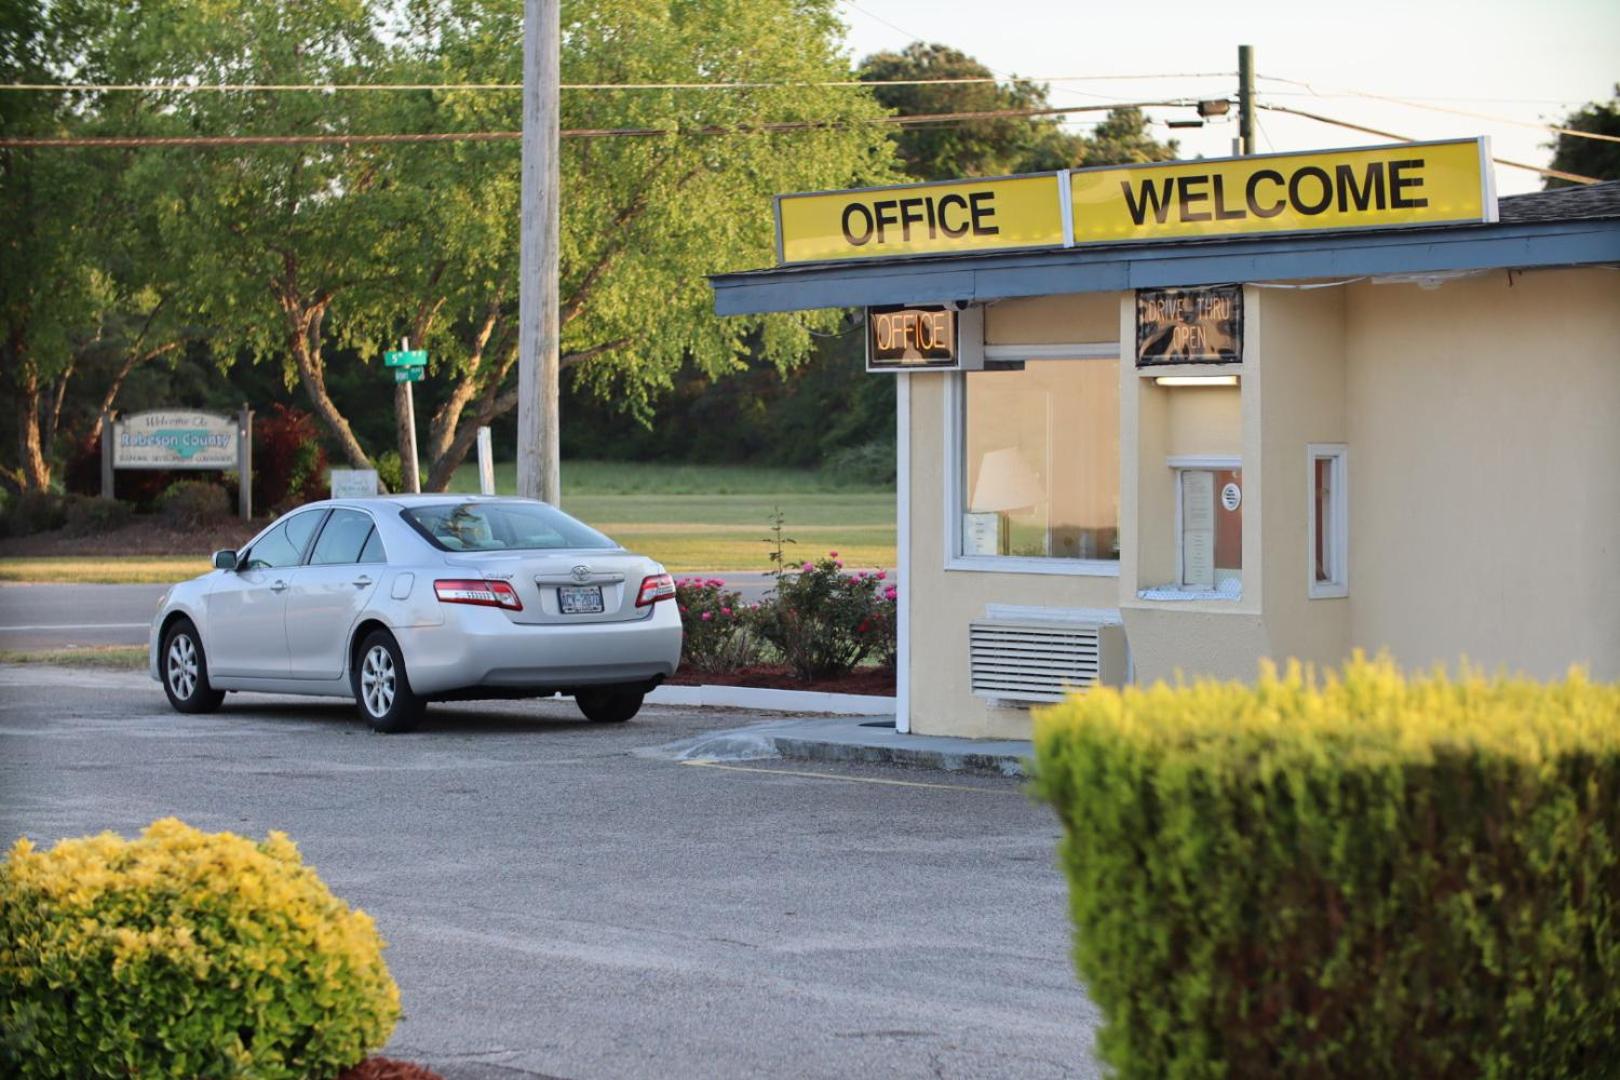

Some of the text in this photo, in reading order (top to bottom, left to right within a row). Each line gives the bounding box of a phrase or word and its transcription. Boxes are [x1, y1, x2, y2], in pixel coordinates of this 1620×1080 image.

[841, 158, 1430, 246] OFFICE WELCOME
[1148, 296, 1231, 322] DRIVE THRU
[876, 313, 946, 351] OFFICE
[1173, 326, 1207, 349] OPEN
[121, 431, 232, 449] Robeson County
